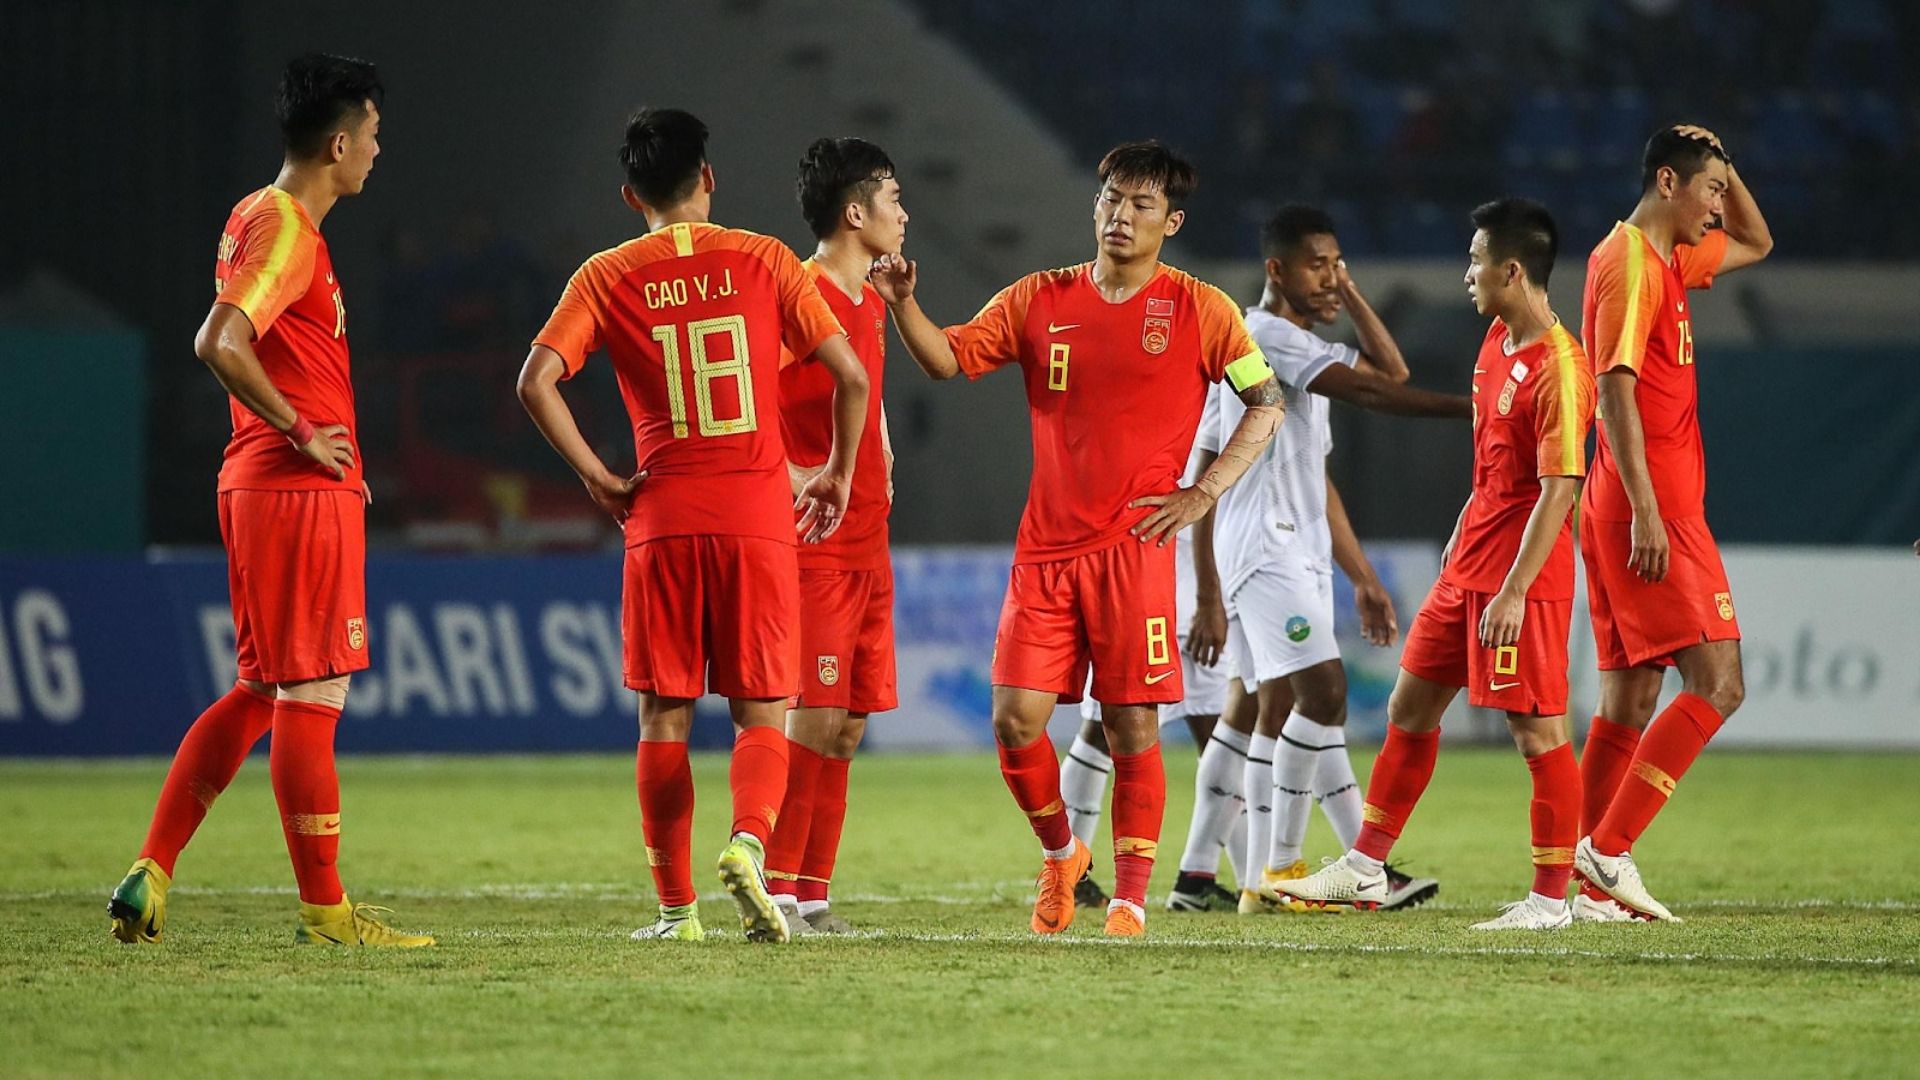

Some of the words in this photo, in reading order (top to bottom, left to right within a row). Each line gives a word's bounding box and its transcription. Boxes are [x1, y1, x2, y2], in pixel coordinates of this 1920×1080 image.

[644, 278, 688, 310] CAO
[693, 268, 739, 302] Y.J.
[1678, 320, 1694, 366] 15
[651, 314, 758, 440] 18
[1049, 344, 1070, 391] 8
[1145, 616, 1170, 666] 8
